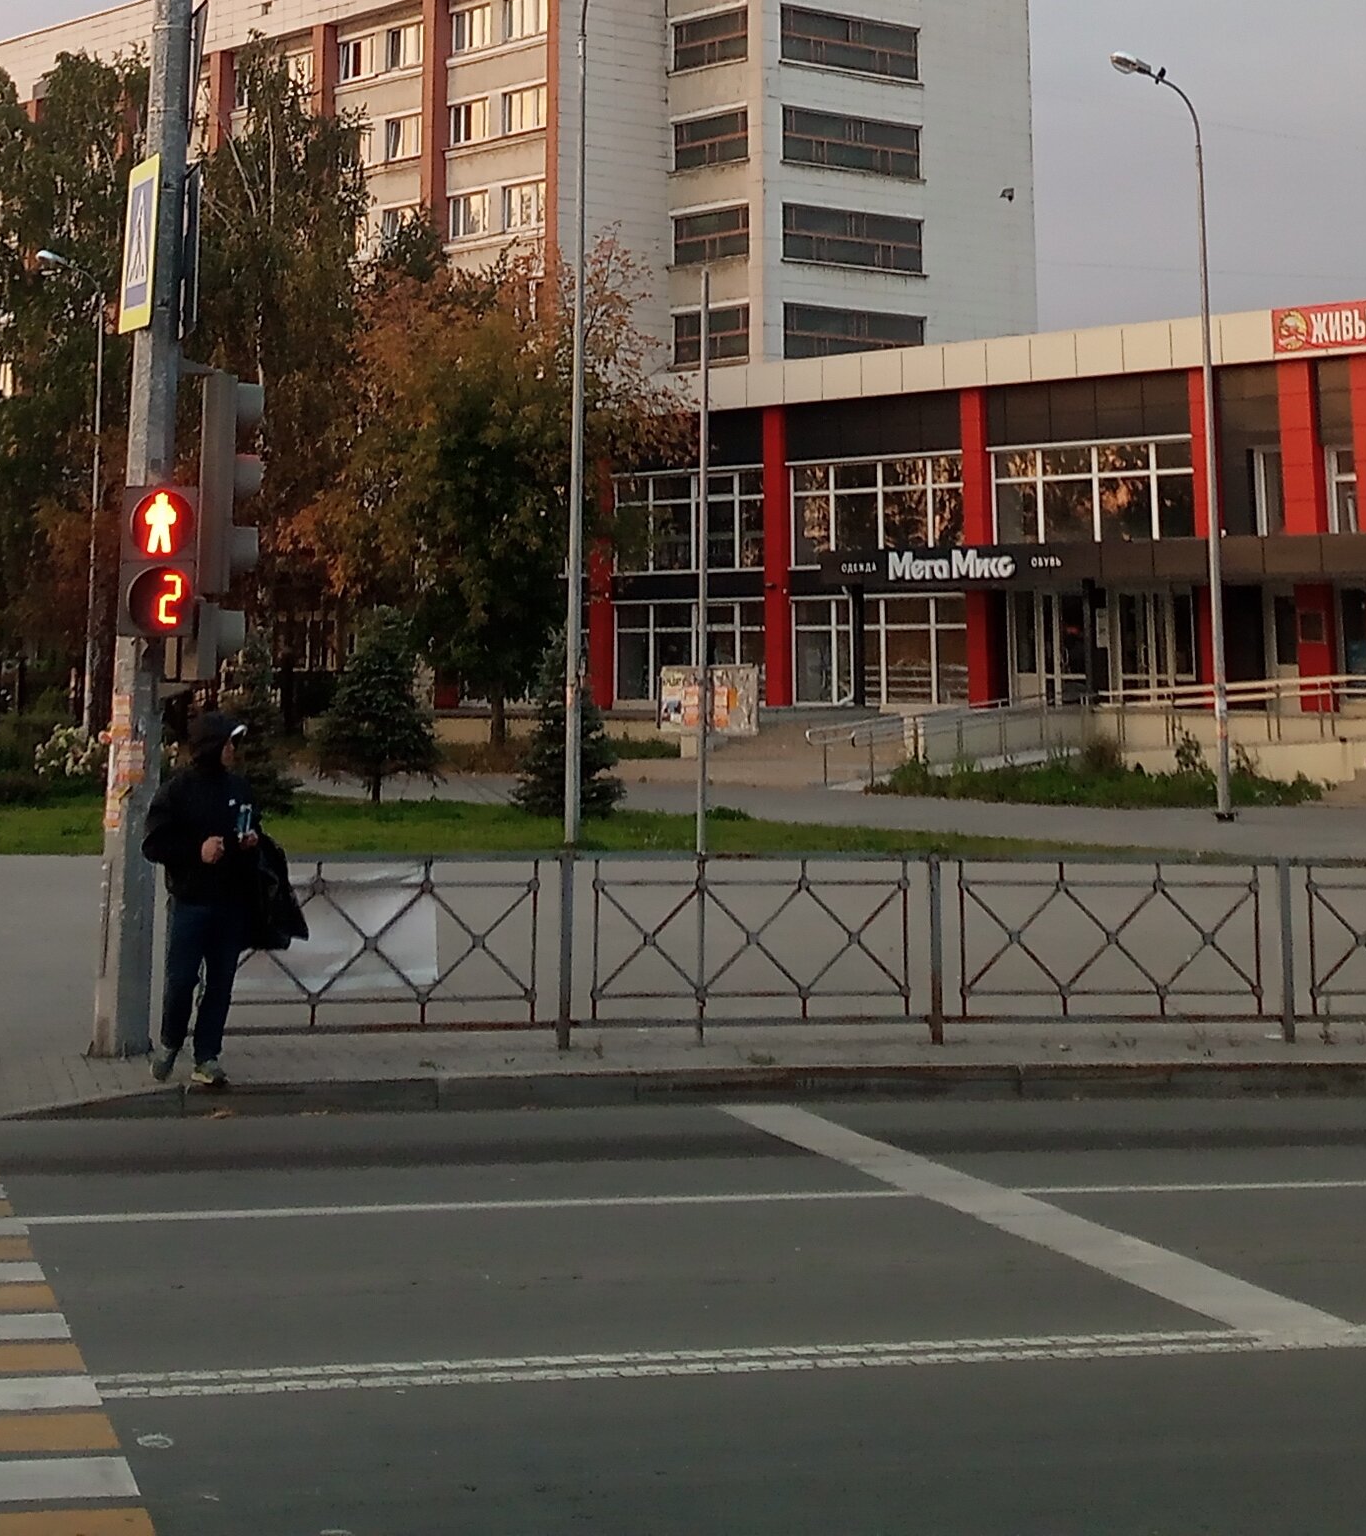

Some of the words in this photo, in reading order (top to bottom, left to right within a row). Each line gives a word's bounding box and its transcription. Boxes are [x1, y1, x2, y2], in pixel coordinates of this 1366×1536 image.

[840, 561, 877, 574] ОДЕЖДА
[1030, 556, 1063, 569] ОБУВЬ
[159, 574, 182, 624] 2
